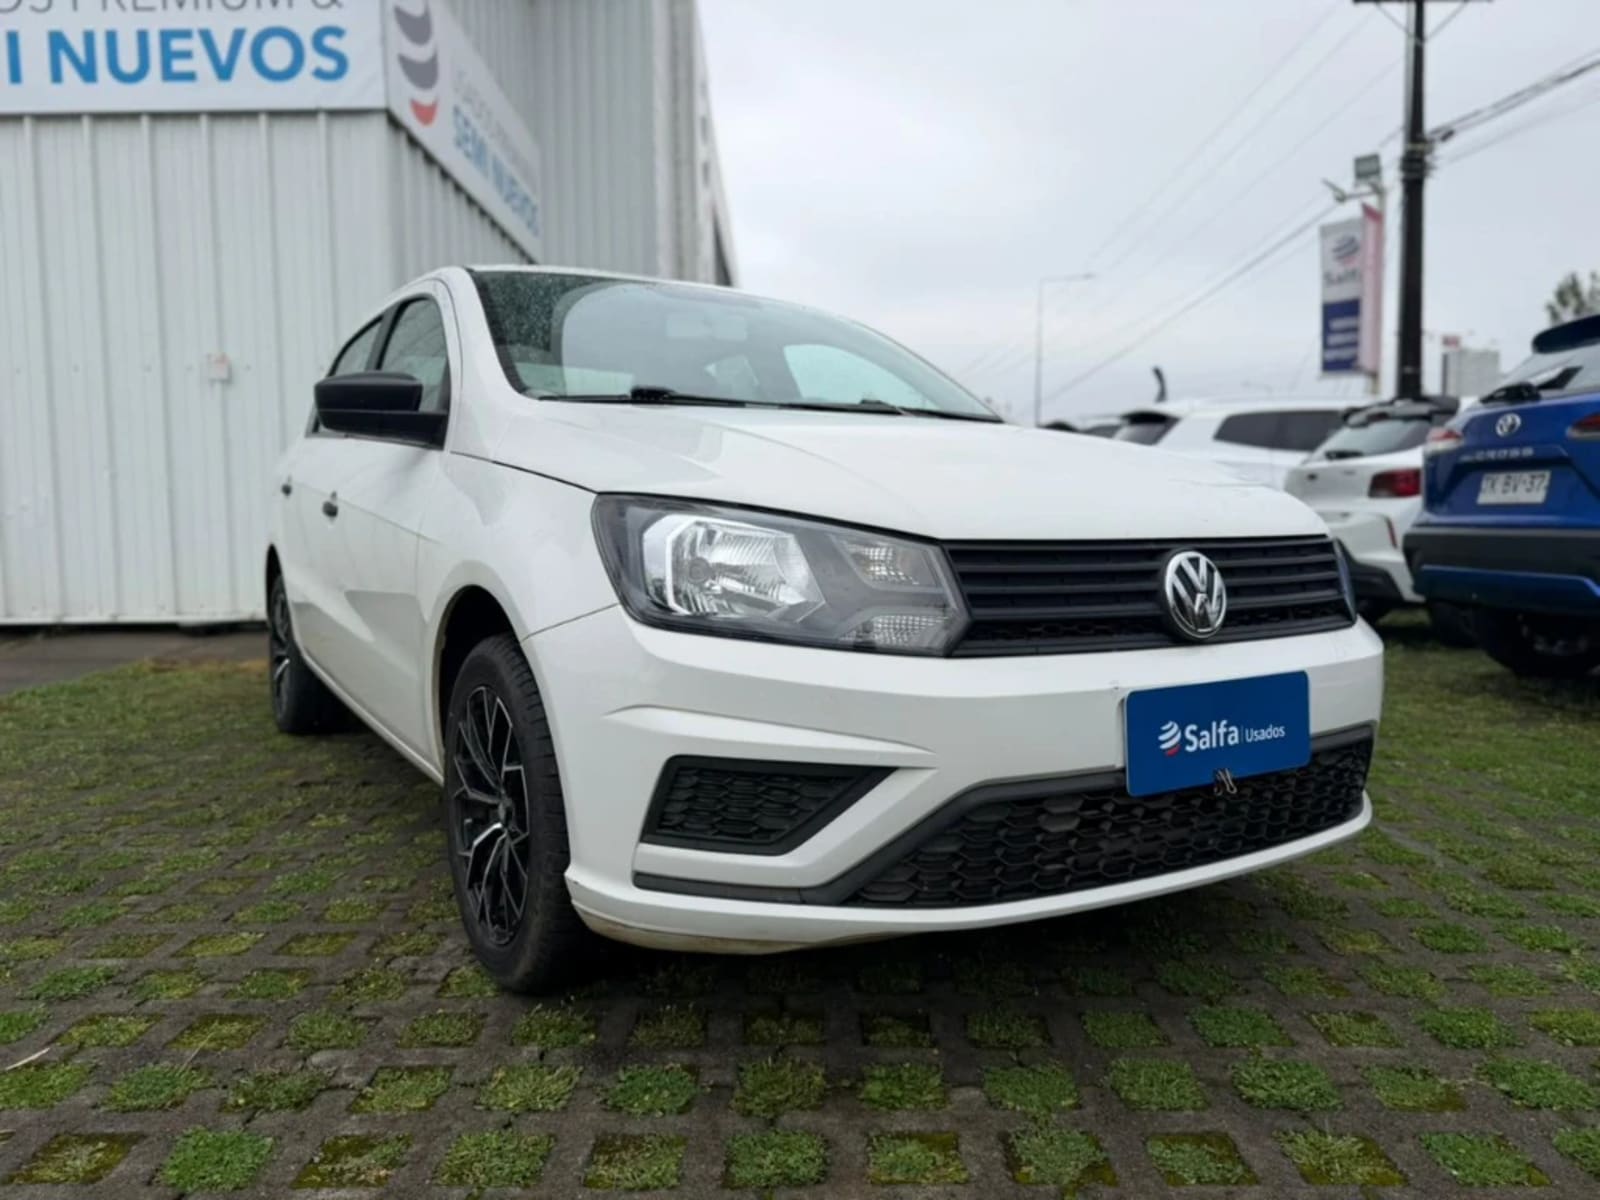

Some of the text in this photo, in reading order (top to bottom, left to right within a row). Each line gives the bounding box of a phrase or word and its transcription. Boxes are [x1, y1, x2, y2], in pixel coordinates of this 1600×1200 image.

[47, 26, 349, 84] NUEVOS
[1184, 719, 1286, 753] Salfa Usados
